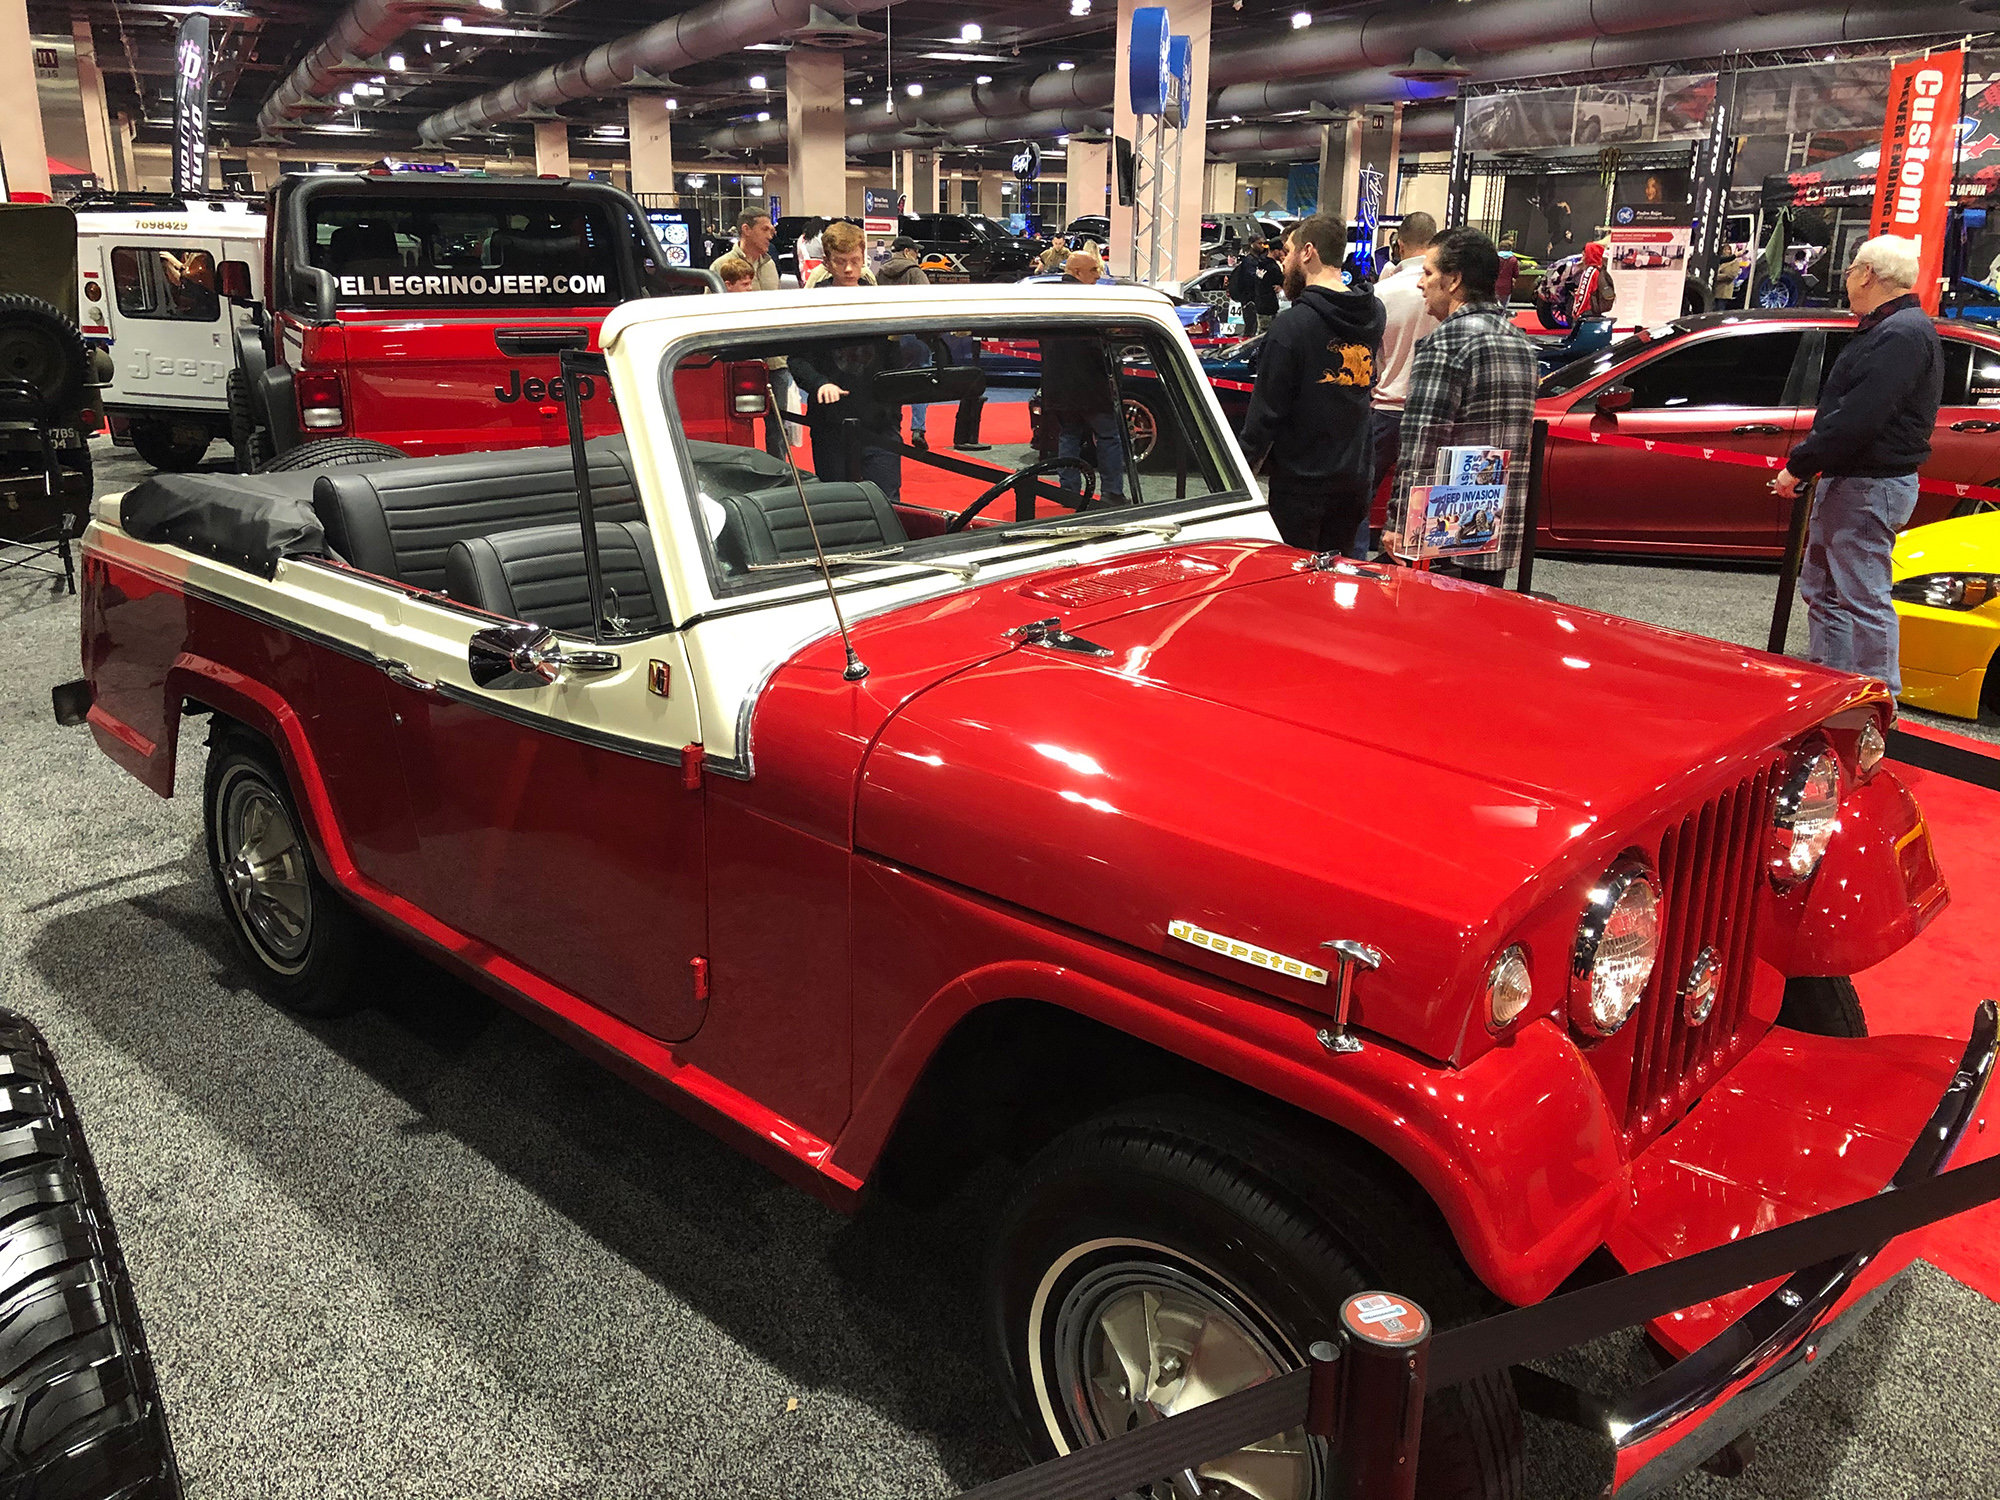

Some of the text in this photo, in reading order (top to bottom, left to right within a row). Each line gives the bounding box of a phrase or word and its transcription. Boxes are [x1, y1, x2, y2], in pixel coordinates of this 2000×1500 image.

[1893, 74, 1914, 139] NEVER
[1710, 105, 1726, 174] NITTO
[1895, 69, 1944, 225] Custom
[1882, 142, 1902, 217] ENDING
[1698, 187, 1712, 254] NITTO
[1713, 188, 1727, 254] NITTO
[918, 252, 970, 273] OX
[127, 348, 225, 385] Jeep
[1462, 488, 1501, 502] INVASION
[1173, 924, 1324, 980] Jeepster
